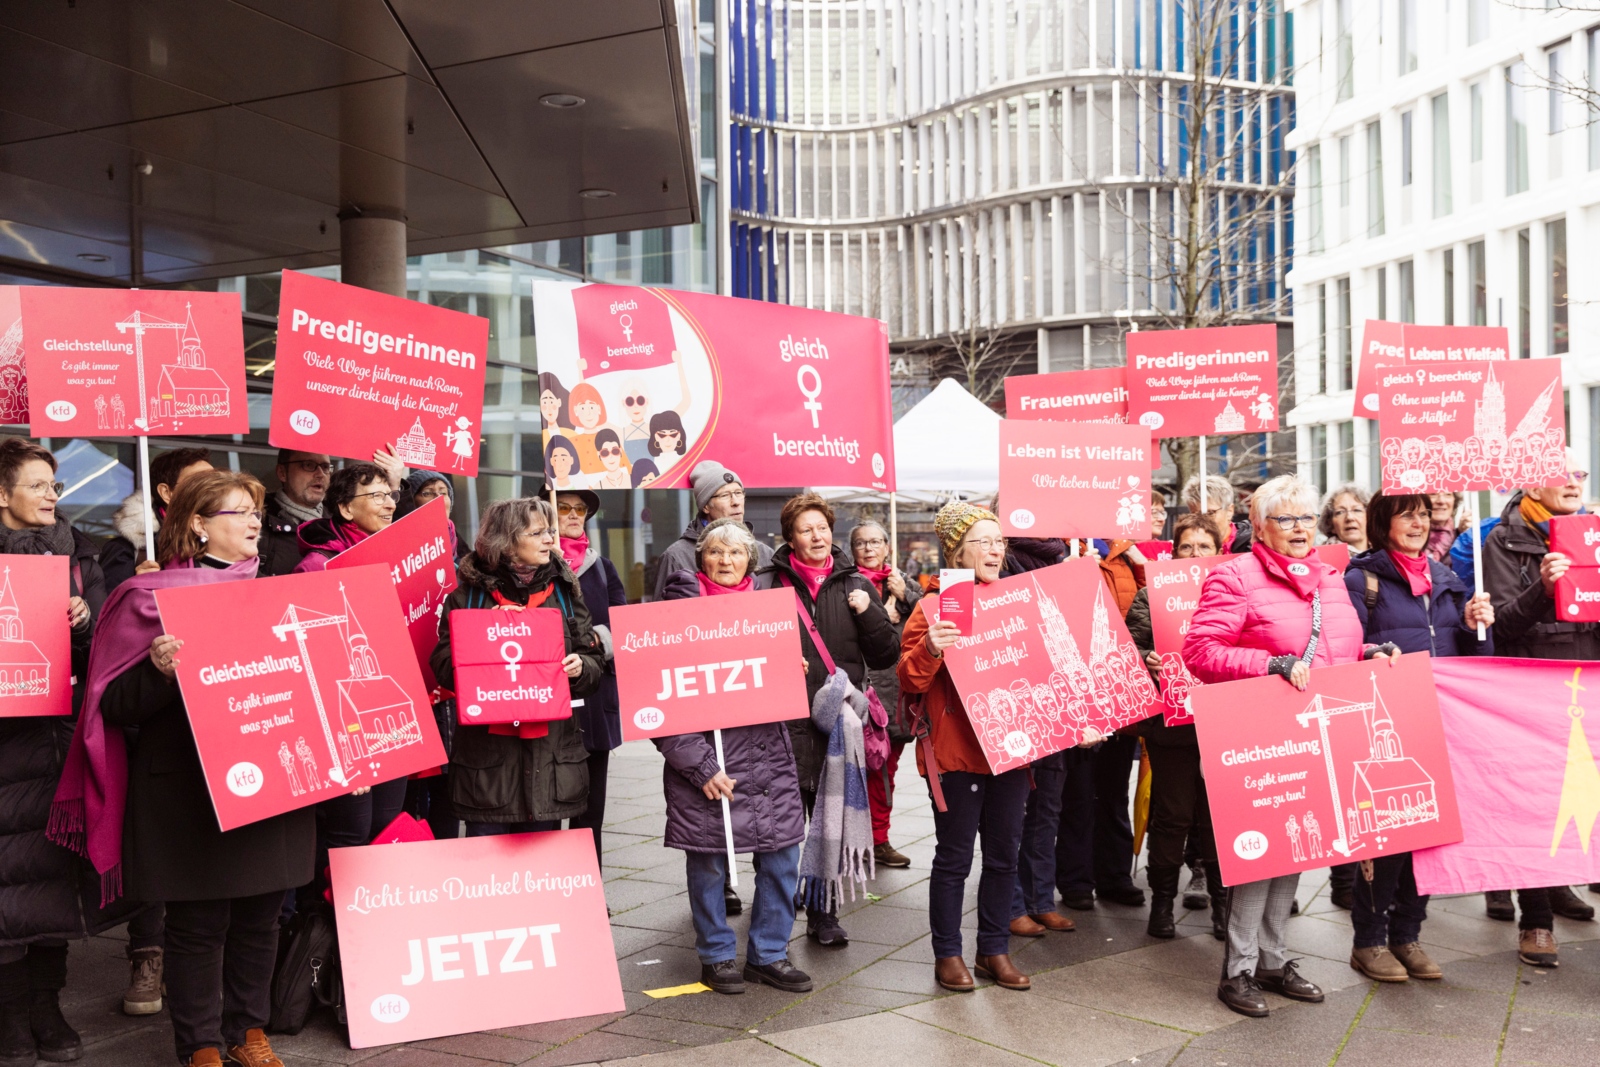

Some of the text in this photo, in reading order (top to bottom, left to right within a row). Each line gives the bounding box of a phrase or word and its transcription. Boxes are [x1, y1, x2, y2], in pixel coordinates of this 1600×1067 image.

[610, 300, 638, 315] gleich
[43, 339, 134, 355] Gleichstellung
[292, 308, 476, 370] Predigerinnen
[780, 334, 829, 362] gleich
[607, 343, 654, 356] berechtigt
[1410, 347, 1506, 361] Leben ist Vielfalt
[62, 360, 120, 374] Es gibt immer
[1136, 350, 1269, 370] Predigerinnen
[86, 379, 96, 388] zu
[98, 375, 116, 384] tun!
[304, 351, 463, 398] Viele Wege führen nach Rom,
[1146, 372, 1261, 388] Viele Wege führen nach Rom,
[1383, 370, 1482, 387] gleich berechtigt
[306, 381, 458, 419] unserer direkt auf die Kanzel!
[1150, 386, 1258, 402] unserer direkt auf die Kanzel!
[1392, 393, 1420, 406] Ohne
[1422, 394, 1440, 404] uns
[1441, 390, 1466, 407] fehlt
[52, 406, 70, 416] kfd
[1145, 415, 1158, 424] kfd
[1402, 410, 1457, 426] die Hälfte!
[296, 415, 314, 429] kfd
[773, 433, 860, 464] berechtigt
[1008, 444, 1144, 461] Leben ist Vielfalt
[1032, 474, 1122, 490] Wir lieben bunt!
[1016, 514, 1030, 524] kfd
[402, 536, 446, 578] Vielfalt
[1154, 570, 1188, 588] gleich
[409, 591, 430, 624] bunt!
[979, 587, 1032, 610] berechtigt
[1166, 596, 1198, 612] Ohne
[487, 622, 532, 641] gleich
[620, 619, 795, 652] Licht ins Dunkel bringen
[984, 628, 1001, 642] uns
[1000, 616, 1028, 640] fehlt
[974, 642, 1030, 672] die Hälfte!
[200, 655, 302, 686] Gleichstellung
[656, 657, 768, 700] JETZT
[228, 690, 293, 714] Es gibt immer
[476, 685, 554, 704] berechtigt
[240, 708, 294, 734] was zu tun!
[640, 712, 658, 724] kfd
[1010, 738, 1026, 751] kfd
[1221, 739, 1321, 766] Gleichstellung
[234, 769, 256, 788] kfd
[1244, 771, 1308, 791] Es gibt immer
[1252, 786, 1306, 808] was zu tun!
[1241, 838, 1261, 853] kfd
[347, 870, 596, 914] Licht ins Dunkel bringen
[401, 924, 560, 986] JETZT
[378, 1001, 402, 1016] kfd
